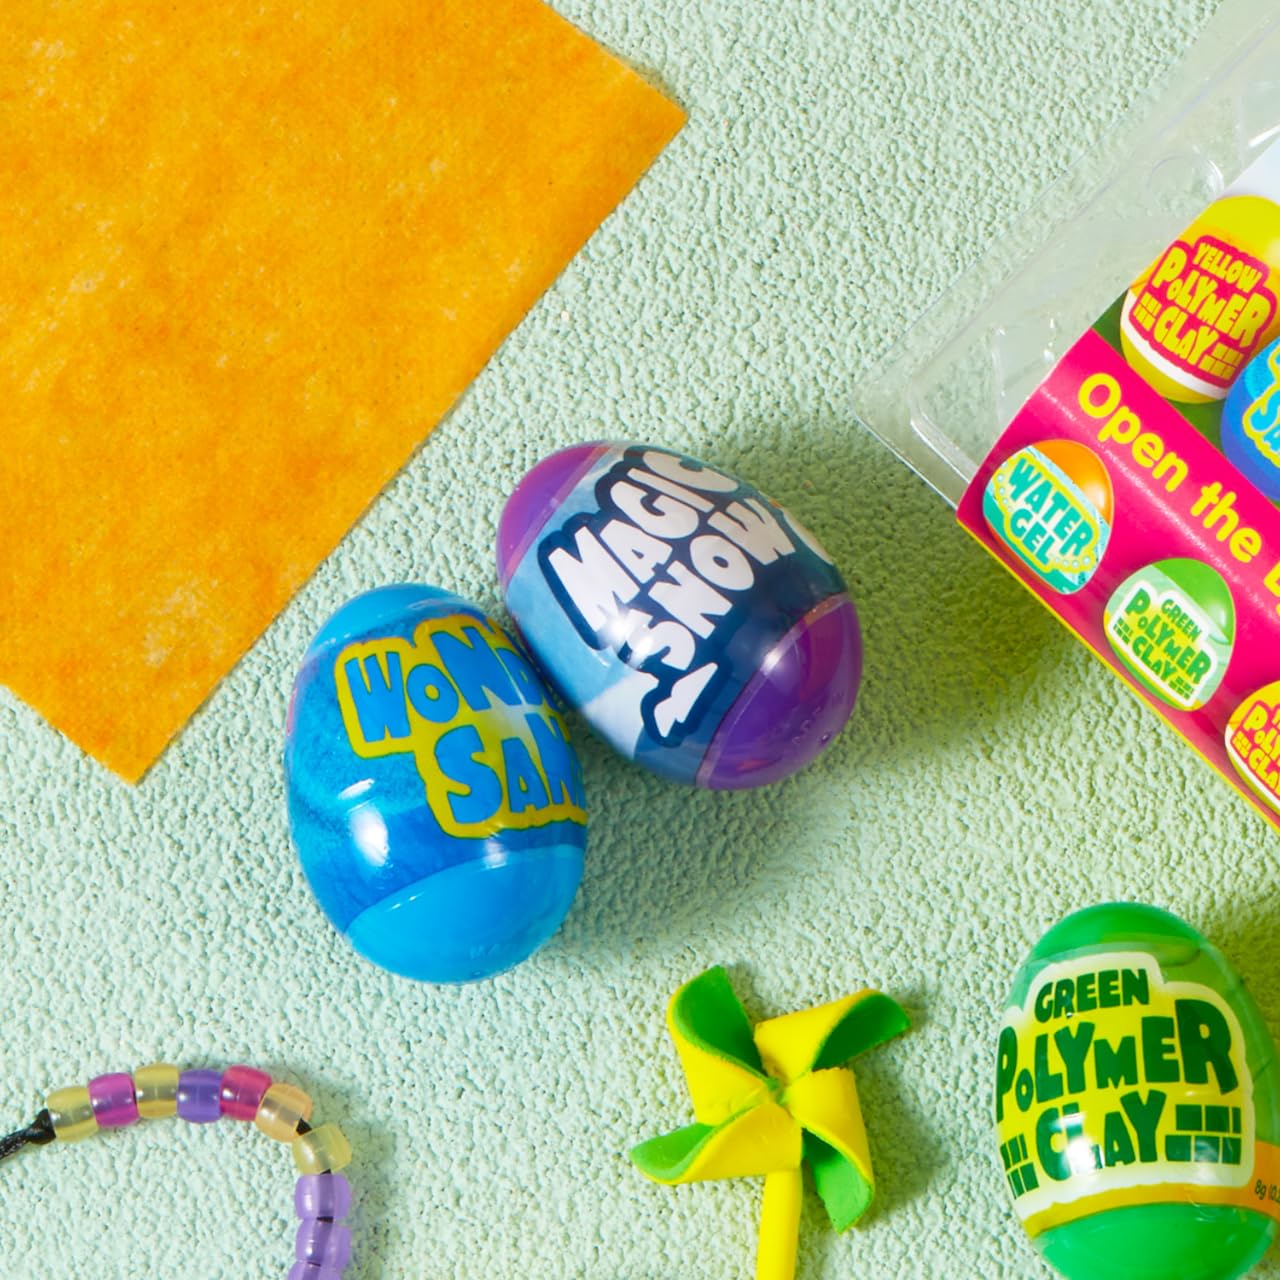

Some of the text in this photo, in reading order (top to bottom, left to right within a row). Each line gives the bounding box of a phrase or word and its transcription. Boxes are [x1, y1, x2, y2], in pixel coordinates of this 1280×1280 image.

[1156, 246, 1273, 349] POLYMER
[1192, 241, 1262, 293] YELLOW
[1153, 314, 1213, 367] CLAY
[1004, 457, 1098, 557] WATER
[1078, 373, 1189, 492] Open
[1188, 480, 1262, 563] the
[549, 450, 737, 633] MAGIC
[626, 498, 796, 669] SNOW
[1010, 513, 1052, 567] GEL
[1125, 587, 1212, 684] POLYMER
[1132, 635, 1177, 681] CLAY
[1161, 598, 1202, 642] GREEN
[1035, 968, 1149, 1022] GREEN
[996, 998, 1238, 1122] POLYMER
[1035, 1089, 1167, 1180] CLAY
